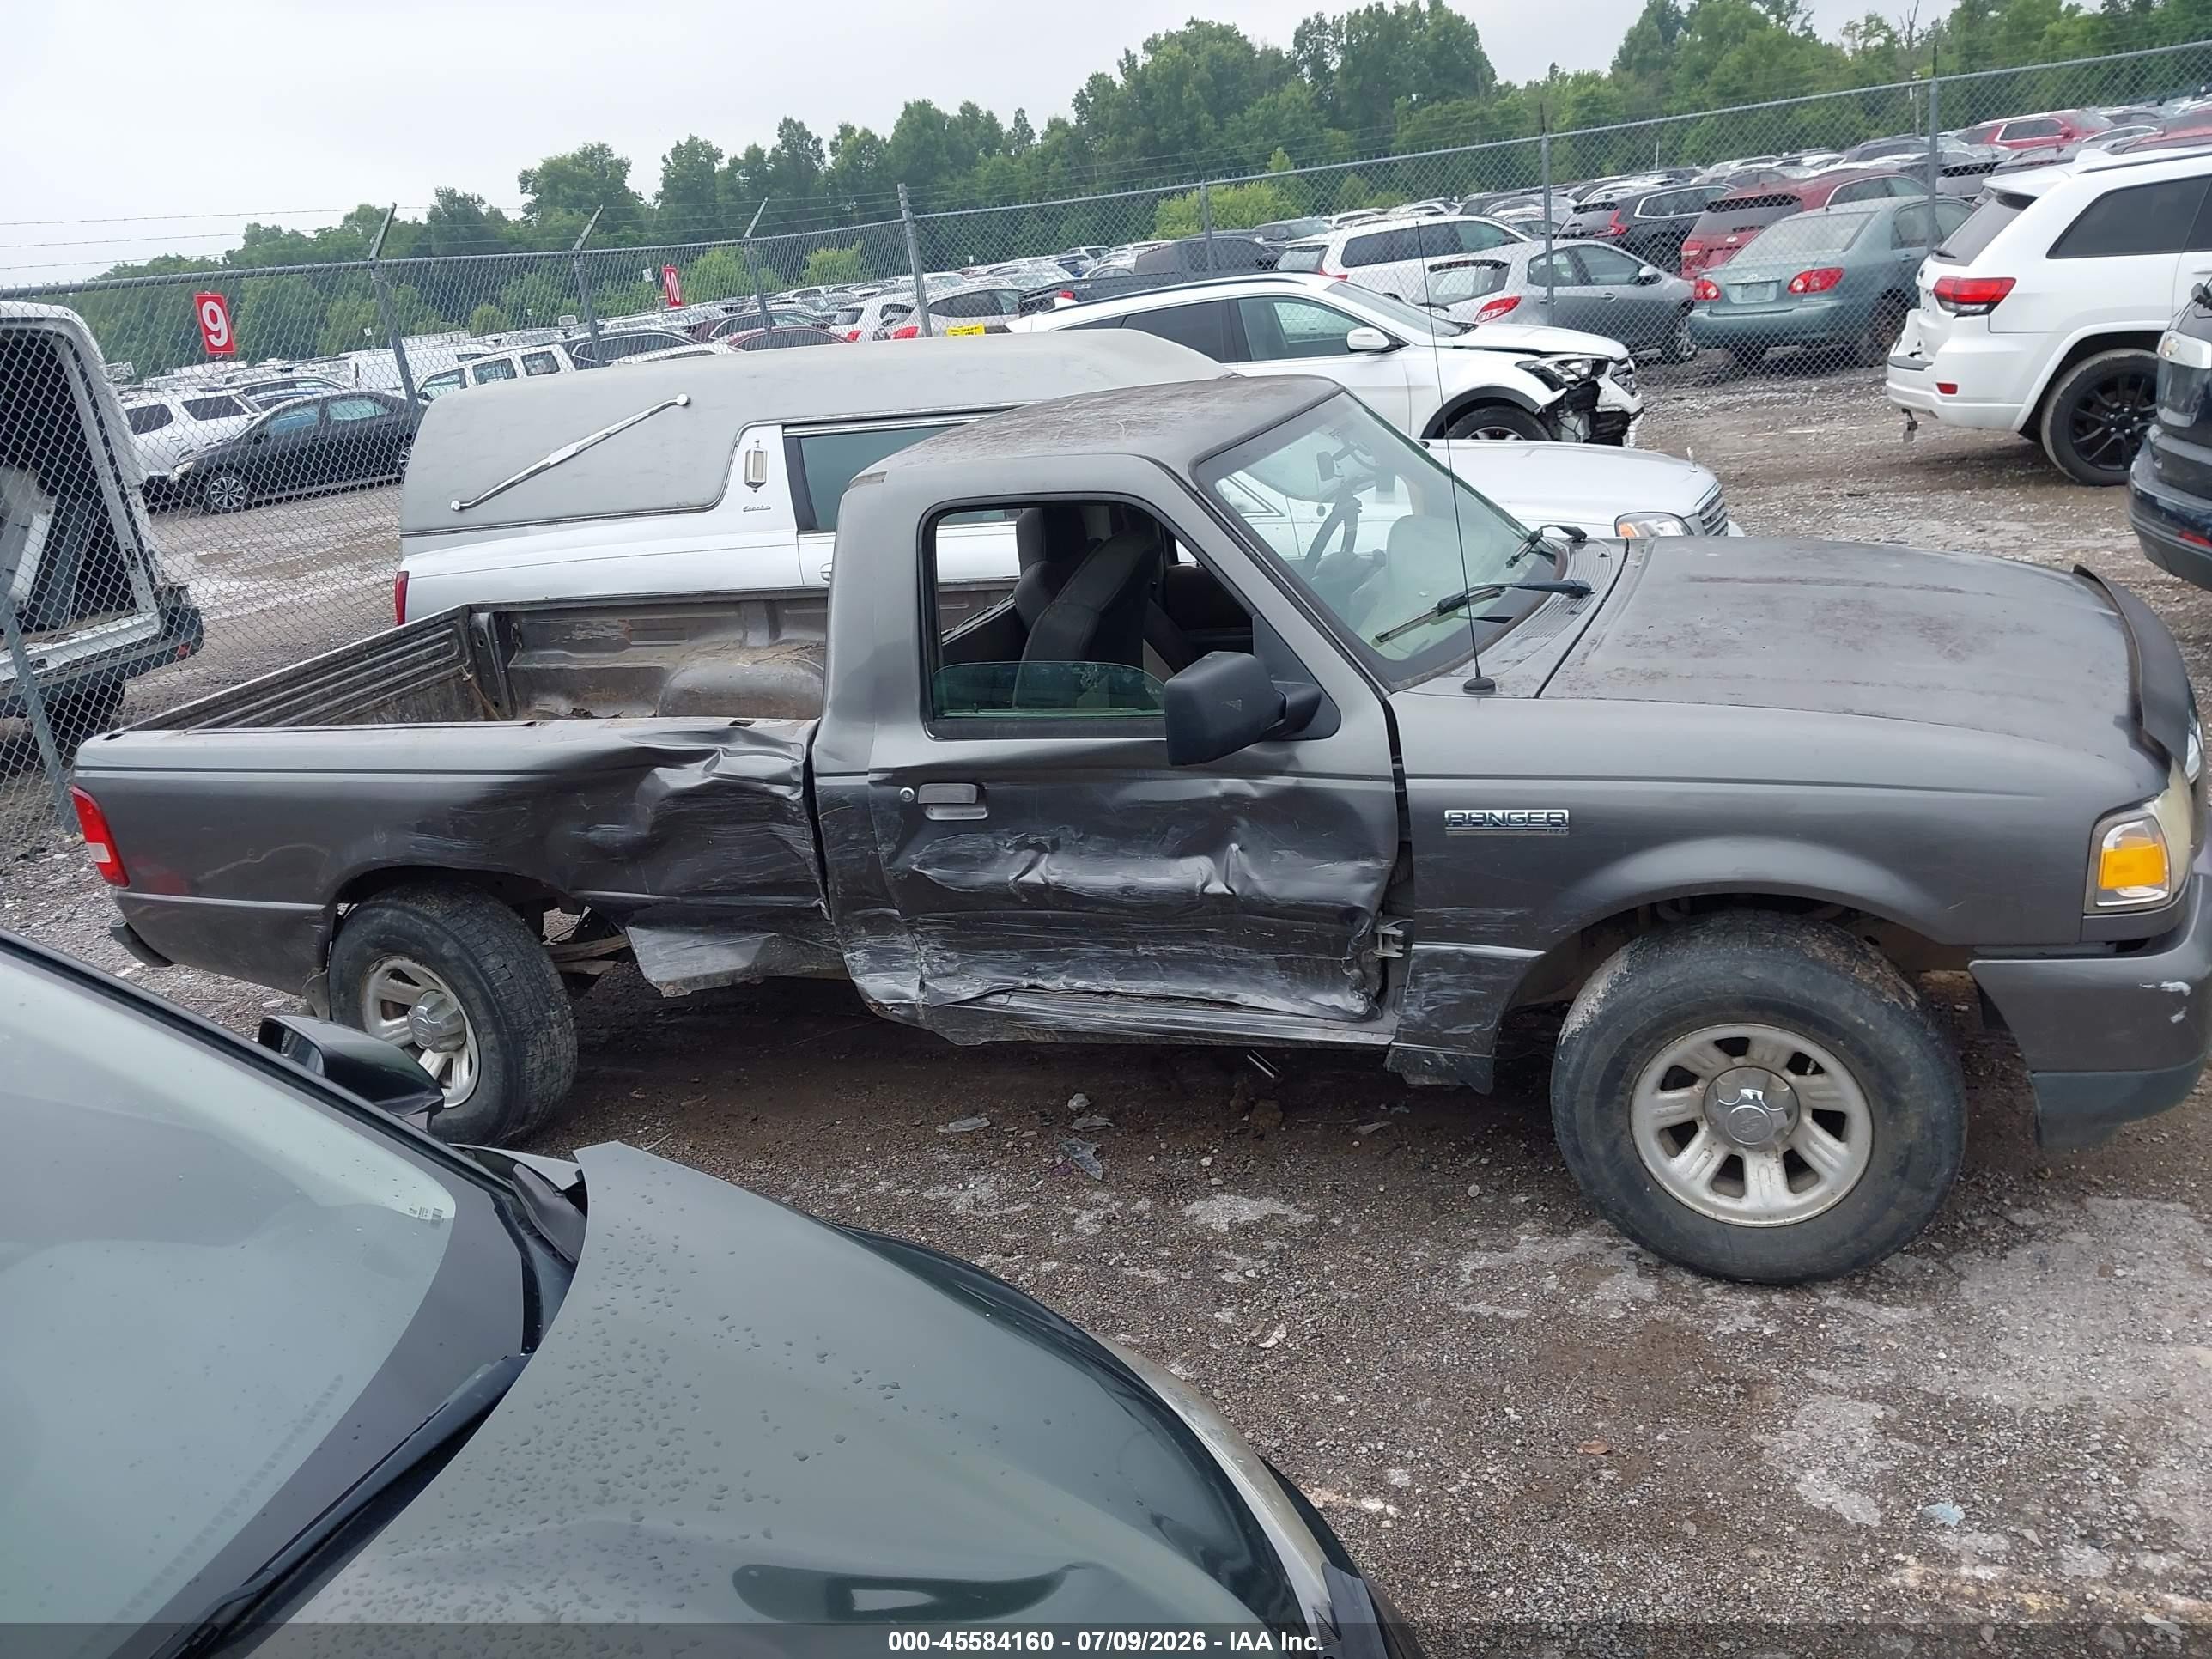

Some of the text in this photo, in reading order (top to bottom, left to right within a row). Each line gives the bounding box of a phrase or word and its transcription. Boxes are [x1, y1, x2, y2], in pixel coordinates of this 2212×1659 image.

[665, 271, 680, 302] 10
[202, 301, 228, 347] 9
[1447, 811, 1568, 827] RANGER
